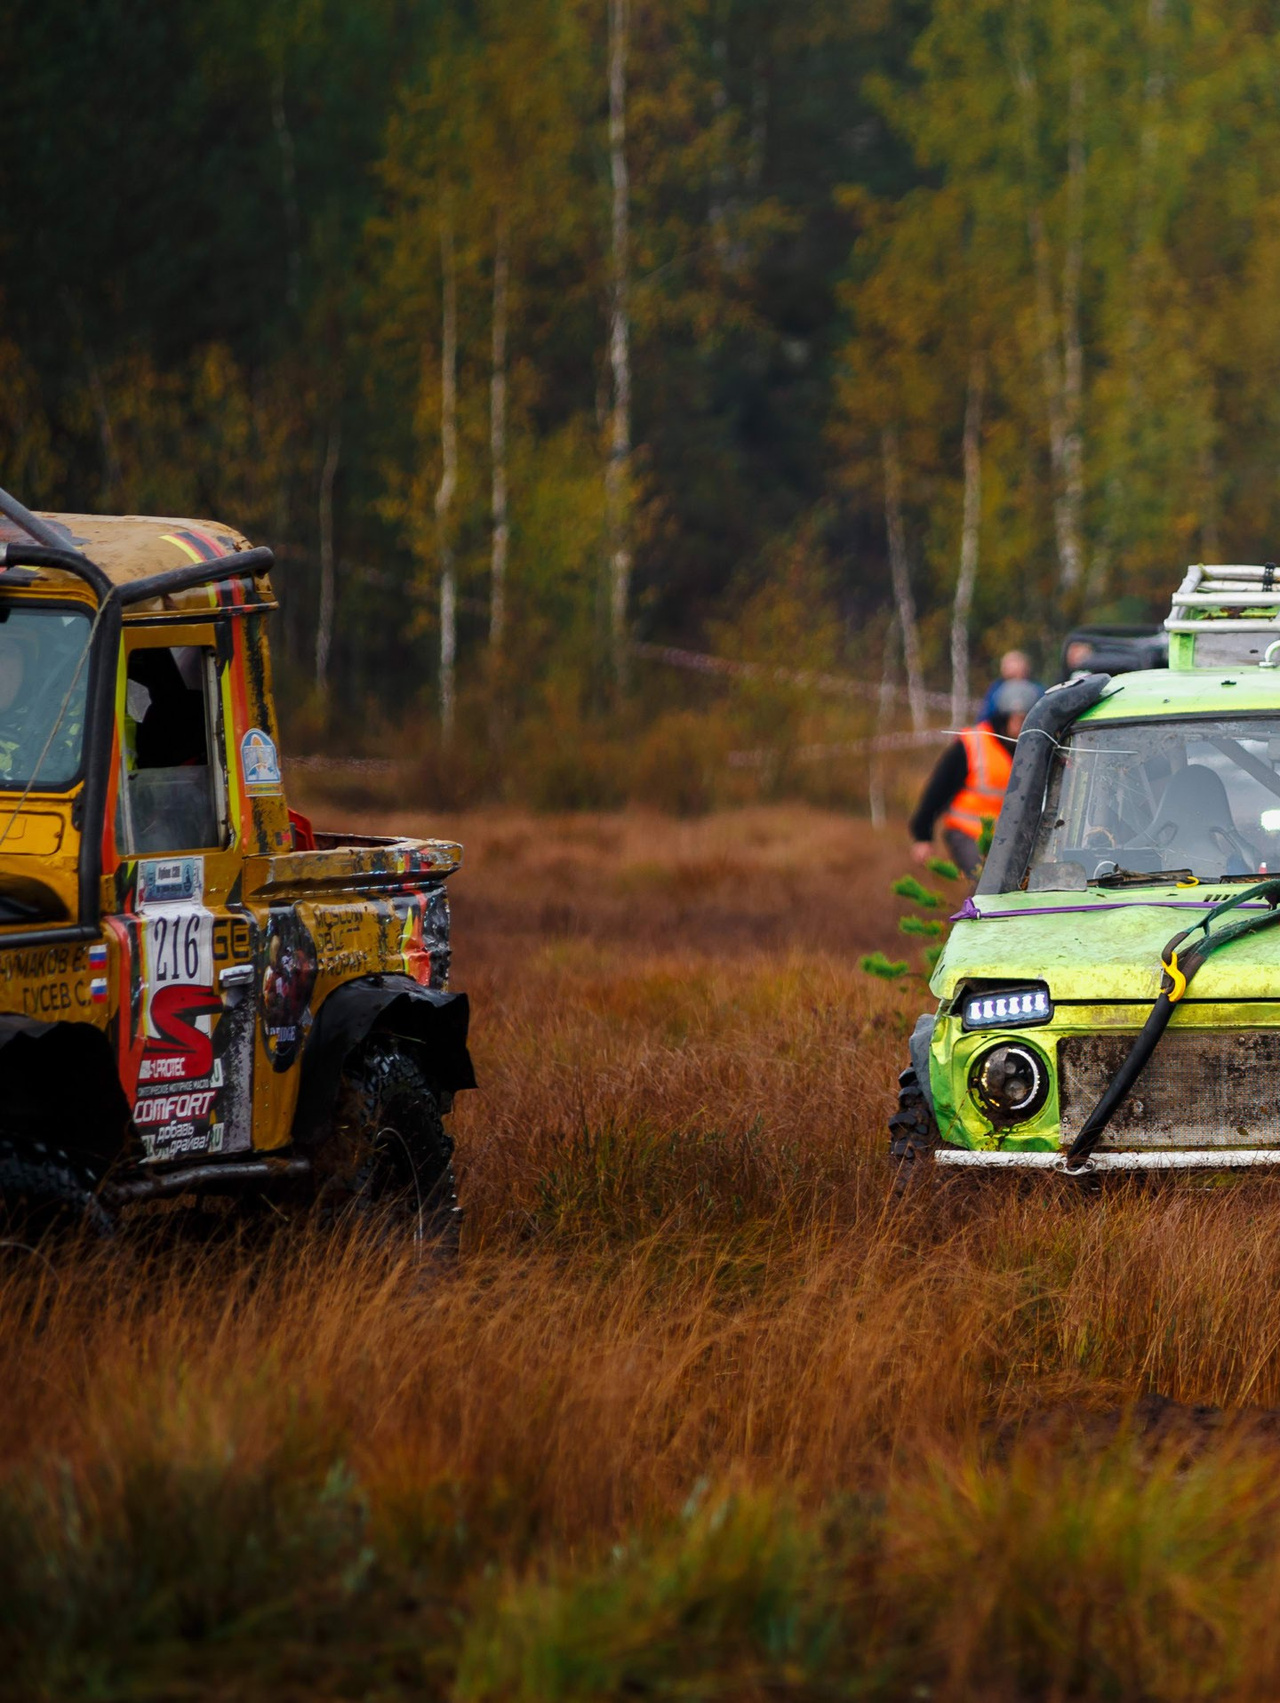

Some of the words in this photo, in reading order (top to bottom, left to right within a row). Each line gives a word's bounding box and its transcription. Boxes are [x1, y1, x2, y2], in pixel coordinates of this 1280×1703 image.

[154, 913, 200, 981] 216
[23, 982, 71, 1013] ГУСЕВ
[133, 1092, 216, 1124] COMFORT
[157, 1120, 194, 1143] добавь
